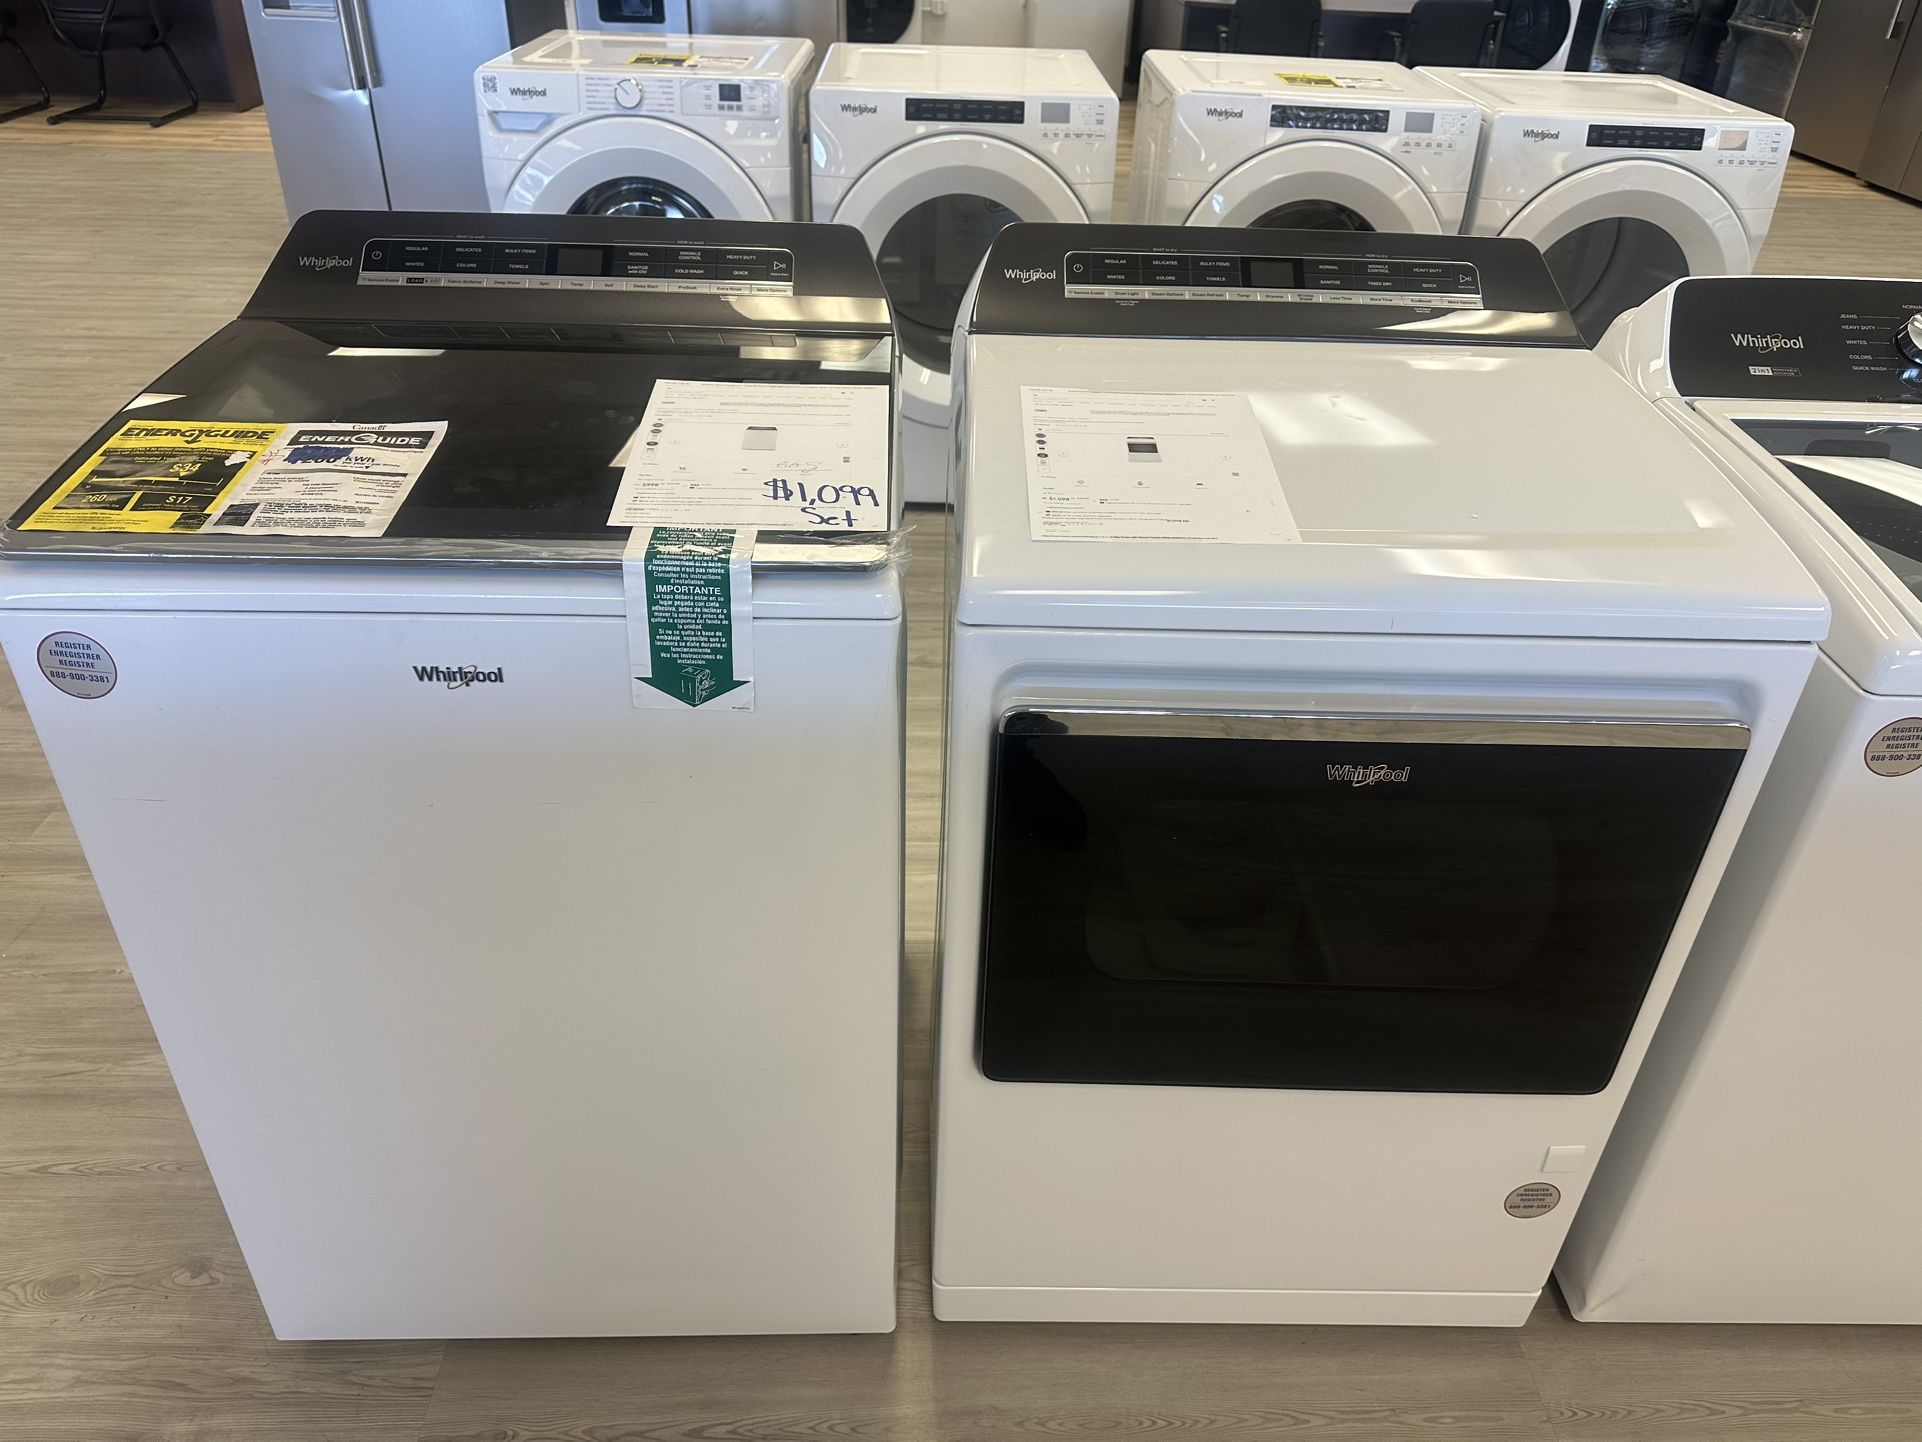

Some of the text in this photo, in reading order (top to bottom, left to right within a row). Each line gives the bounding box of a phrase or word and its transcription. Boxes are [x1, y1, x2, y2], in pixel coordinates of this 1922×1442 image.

[509, 87, 547, 100] Whirlpool
[840, 103, 877, 117] Whirlpool
[1206, 107, 1243, 121] Whirlpool
[1523, 129, 1560, 143] Whirlpool
[299, 255, 353, 271] Whirlpool
[1004, 268, 1056, 283] Whirlpool
[1731, 333, 1804, 353] Whirlpool
[120, 427, 276, 445] ENERGYGUIDE
[170, 463, 202, 473] $34
[82, 494, 107, 503] 260
[763, 477, 880, 507] $1,099
[166, 495, 192, 504] $17
[801, 506, 858, 527] Set
[655, 584, 722, 595] IMPORTANTE
[54, 640, 92, 651] REGISTER
[48, 649, 101, 661] ENREGISTRER
[58, 658, 96, 669] REGISTRE
[49, 670, 110, 683] 888-900-3381
[412, 664, 504, 690] Whirlpool
[1881, 734, 1922, 742] ENREGISTRE
[1885, 742, 1920, 750] REGISTRE
[1870, 753, 1922, 762] 888-900-338
[1326, 764, 1411, 787] Whirlpool
